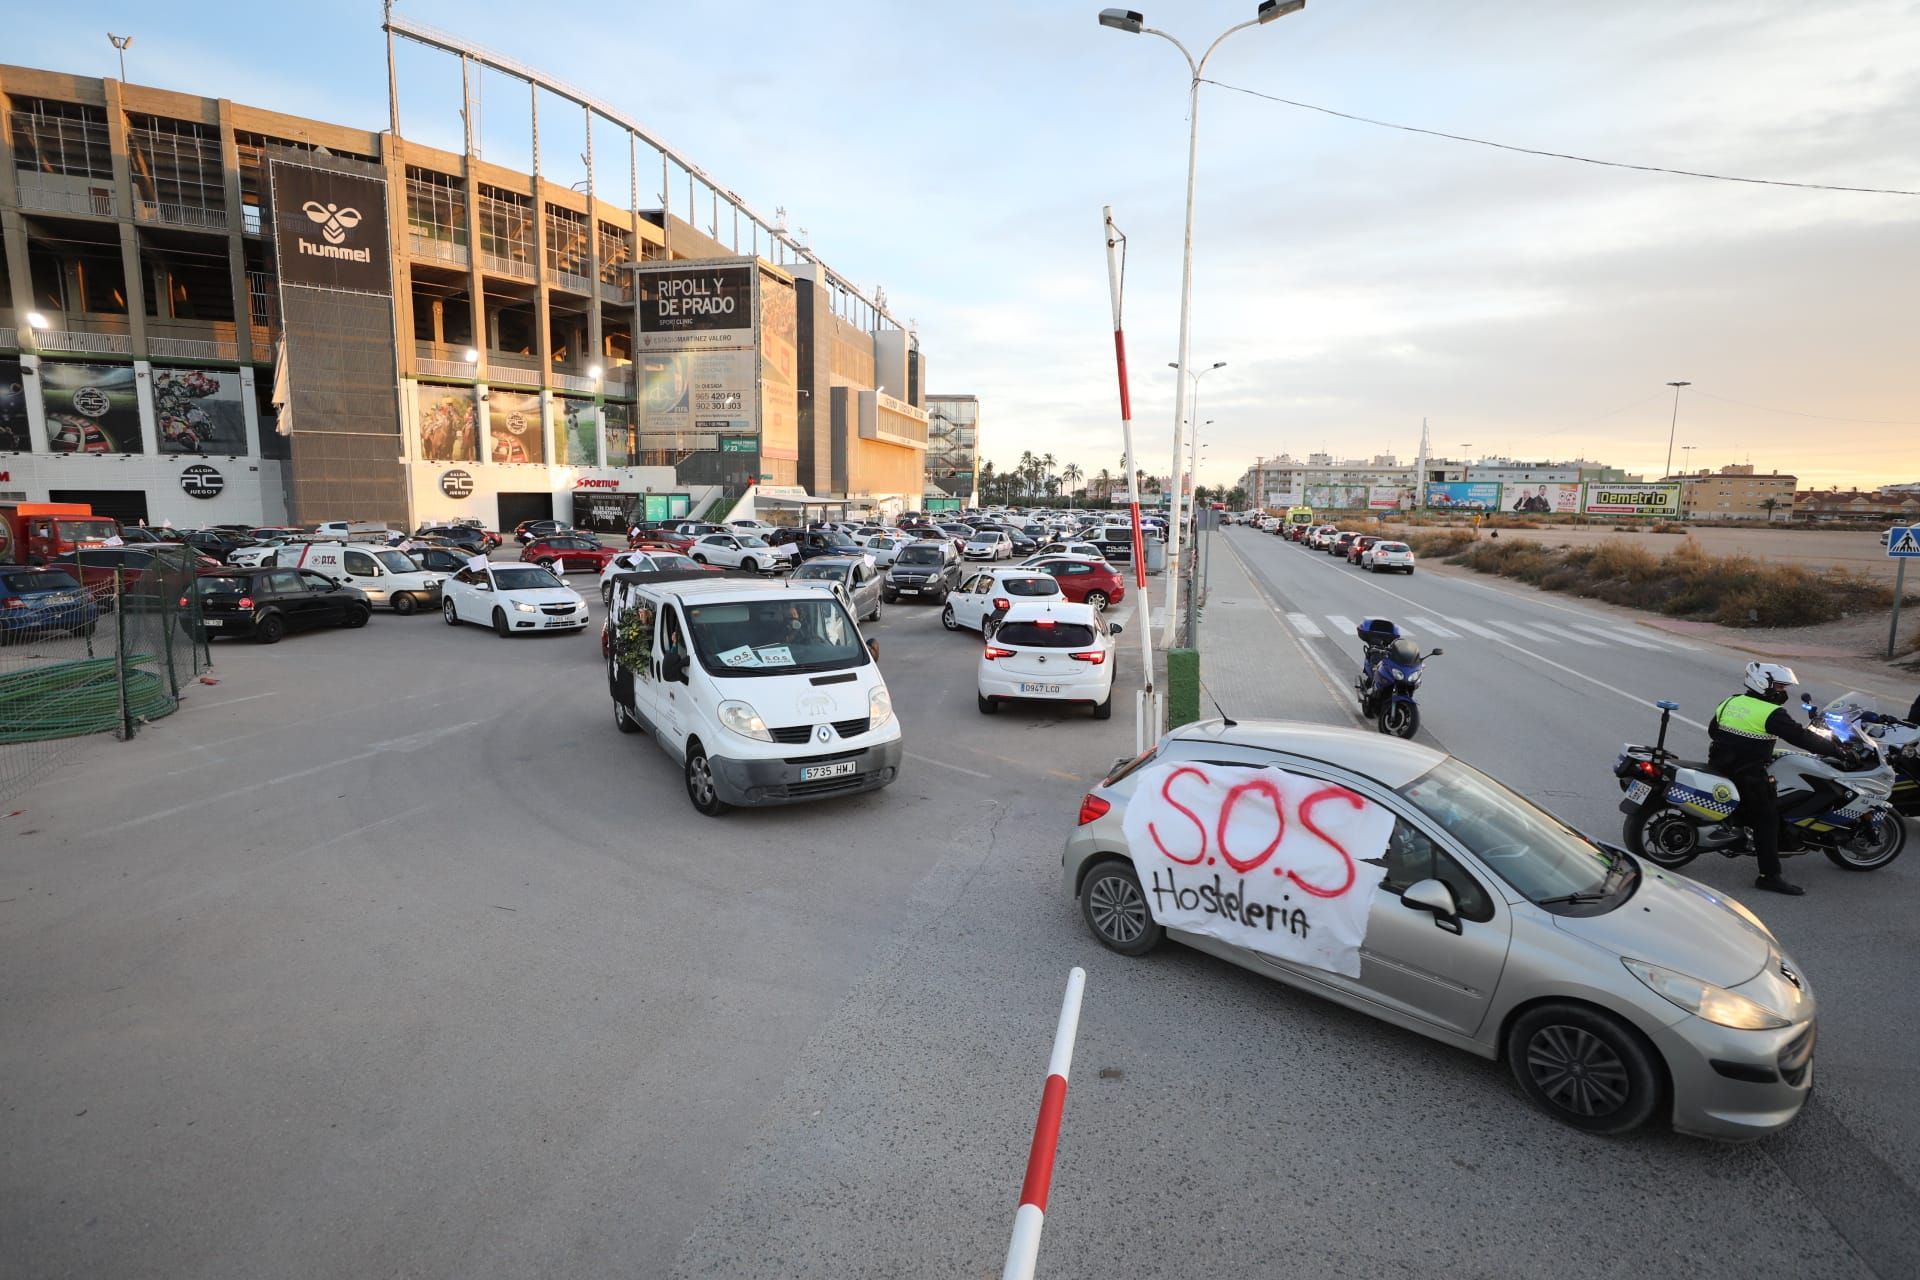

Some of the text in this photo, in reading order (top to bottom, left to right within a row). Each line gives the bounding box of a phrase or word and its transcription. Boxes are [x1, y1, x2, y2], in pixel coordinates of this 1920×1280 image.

[298, 238, 370, 263] hummel
[658, 278, 724, 297] RIPOLL Y
[658, 296, 734, 316] DE PRADO
[573, 478, 620, 488] SPORTIUM
[1600, 492, 1666, 505] Demetrio
[806, 762, 854, 778] 5735 HMJ
